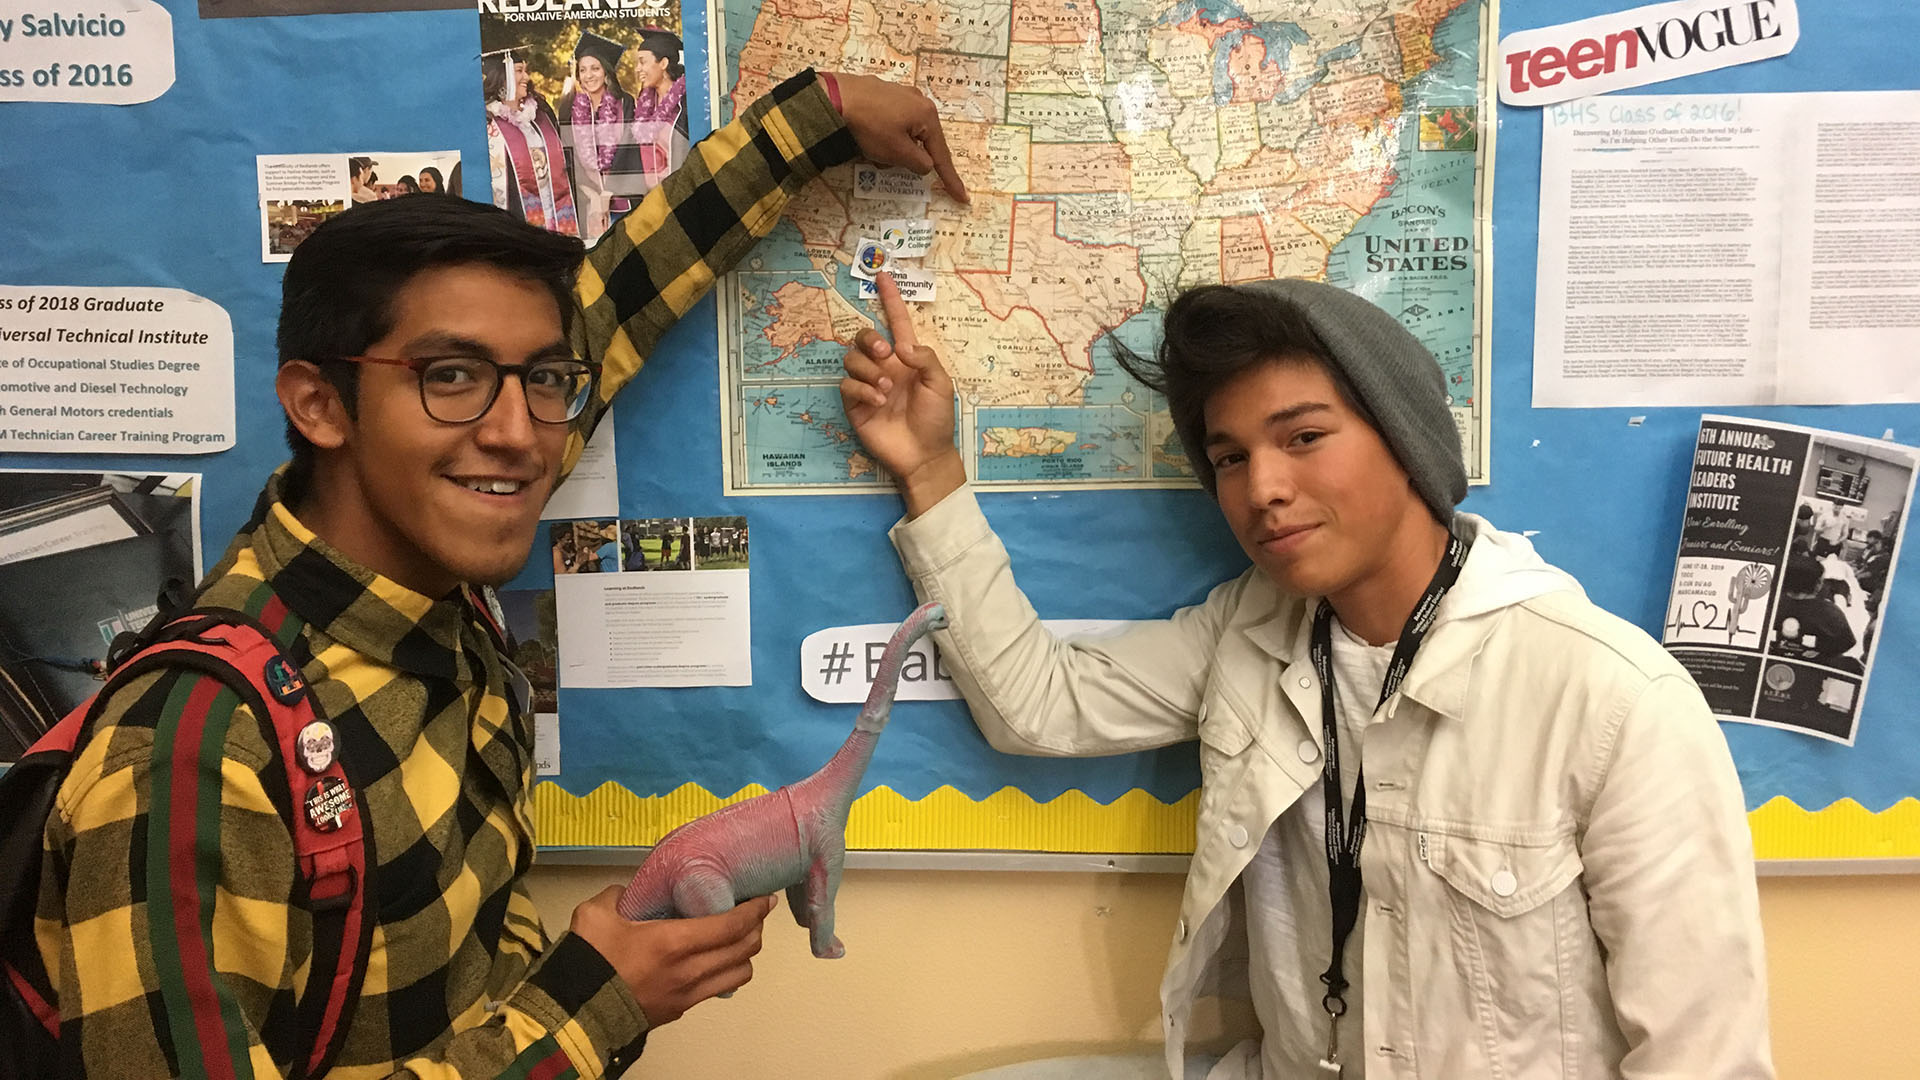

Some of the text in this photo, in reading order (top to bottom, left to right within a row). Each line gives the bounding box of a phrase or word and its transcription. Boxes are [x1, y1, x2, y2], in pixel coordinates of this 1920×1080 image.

[505, 7, 671, 22] FOR NATIVE AMERICAN STUDENTS
[897, 11, 989, 26] MONTANA
[21, 12, 125, 37] Salvicio
[764, 39, 826, 58] OREGON
[860, 56, 906, 69] IDAHO
[32, 62, 60, 87] of
[68, 63, 133, 87] 2016
[926, 74, 991, 88] WYOMING
[1552, 99, 1743, 126] BHS Class of 2016!
[1391, 204, 1446, 219] BACON'S
[907, 228, 932, 236] Central
[963, 231, 1005, 239] MEXICO
[907, 242, 932, 250] College
[1273, 239, 1321, 252] GEORGIA
[1365, 235, 1469, 253] UNITED
[1367, 253, 1468, 273] STATES
[1004, 276, 1123, 286] TEXAS
[17, 296, 36, 313] of
[39, 296, 79, 311] 2018
[84, 297, 164, 312] Graduate
[56, 328, 134, 344] Technical
[138, 329, 209, 345] Institute
[12, 357, 25, 369] of
[28, 358, 107, 372] Occupational
[109, 359, 155, 370] Studies
[158, 360, 200, 373] Degree
[54, 382, 77, 393] and
[80, 383, 116, 394] Diesel
[120, 383, 188, 397] Technology
[9, 406, 57, 417] General
[60, 406, 104, 418] Motors
[107, 407, 174, 419] credentials
[11, 429, 75, 441] Technician
[78, 430, 118, 442] Career
[120, 431, 169, 444] Training
[172, 431, 225, 444] Program
[1696, 449, 1793, 475] FUTURE HEALTH
[1693, 471, 1737, 489] LEADERS
[1688, 493, 1741, 511] INSTITUTE
[1702, 516, 1749, 535] Enrolling
[1710, 540, 1733, 551] and
[1730, 541, 1780, 556] Seniors!
[329, 782, 346, 796] WHAT
[310, 788, 351, 819] AWESOME
